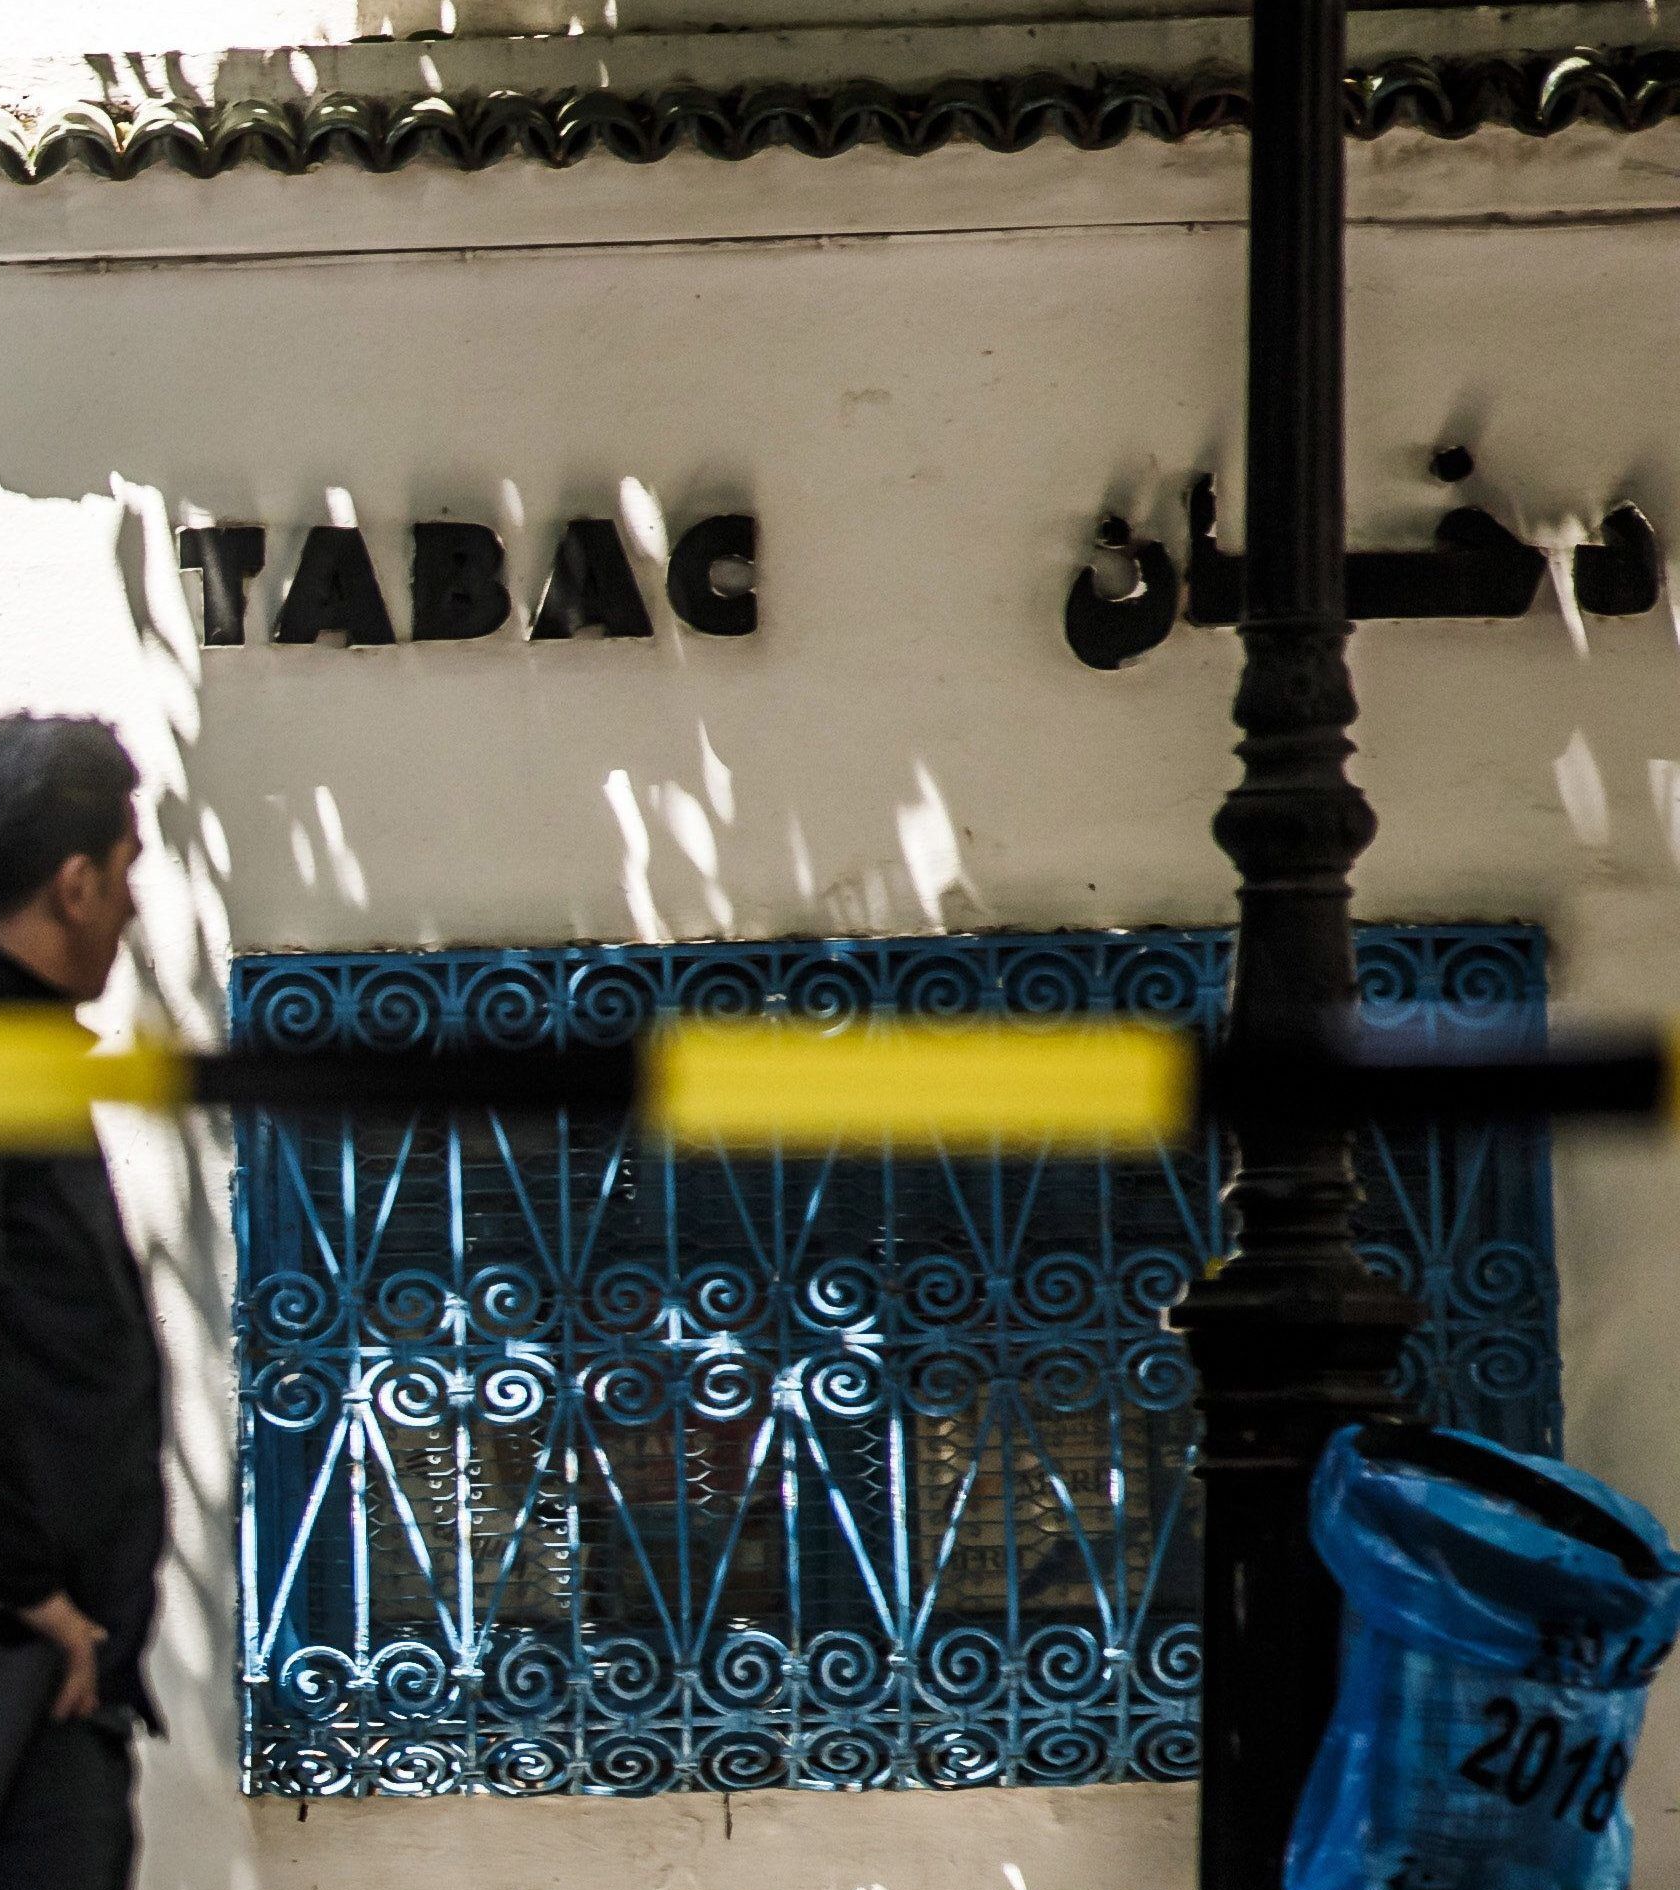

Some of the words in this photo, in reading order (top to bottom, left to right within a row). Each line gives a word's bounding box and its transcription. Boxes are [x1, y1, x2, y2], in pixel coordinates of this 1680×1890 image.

[176, 513, 761, 650] TABAC
[1064, 443, 1661, 673] دخان
[1460, 1697, 1630, 1833] 2018
